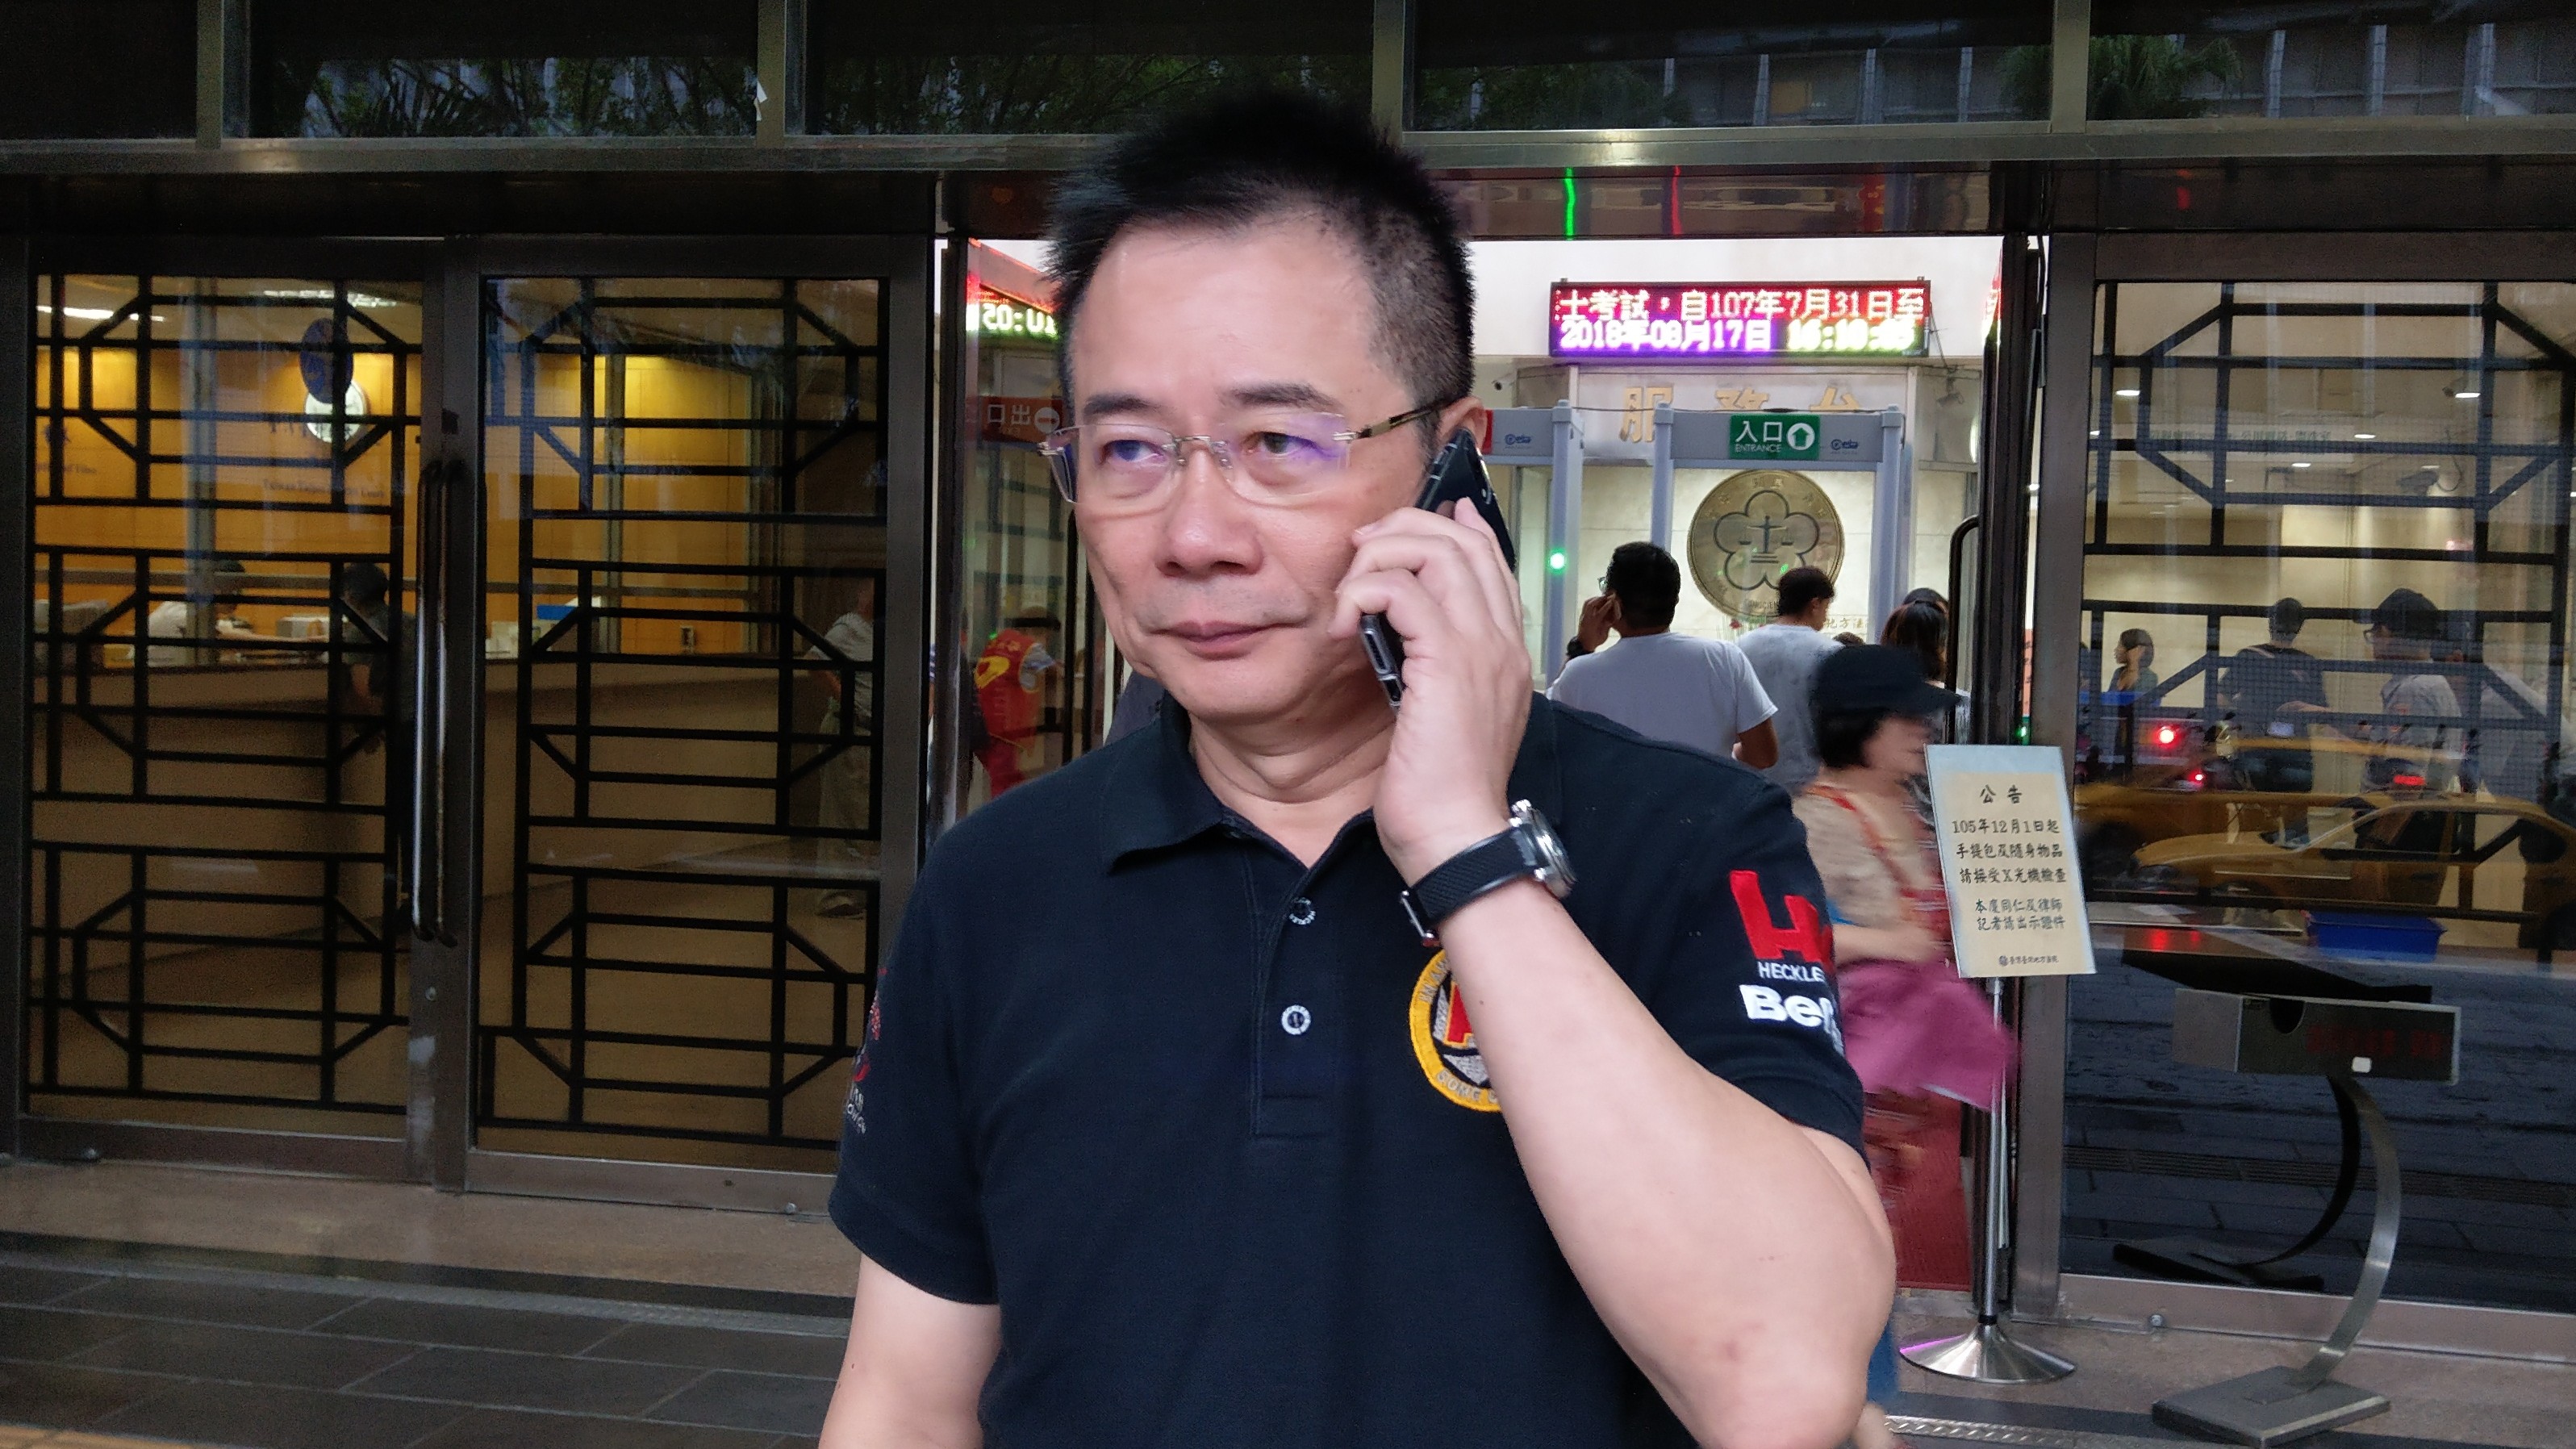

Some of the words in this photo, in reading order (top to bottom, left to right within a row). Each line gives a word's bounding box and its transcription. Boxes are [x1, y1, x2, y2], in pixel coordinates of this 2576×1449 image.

[1735, 420, 1783, 443] 入口
[1735, 443, 1781, 453] ENTRANCE
[1979, 783, 2023, 804] 公告
[1952, 818, 2060, 834] 105年12月1日起
[1956, 843, 2063, 859] 手提包及隨身物品
[1960, 867, 2066, 884] 請接受X光機檢查
